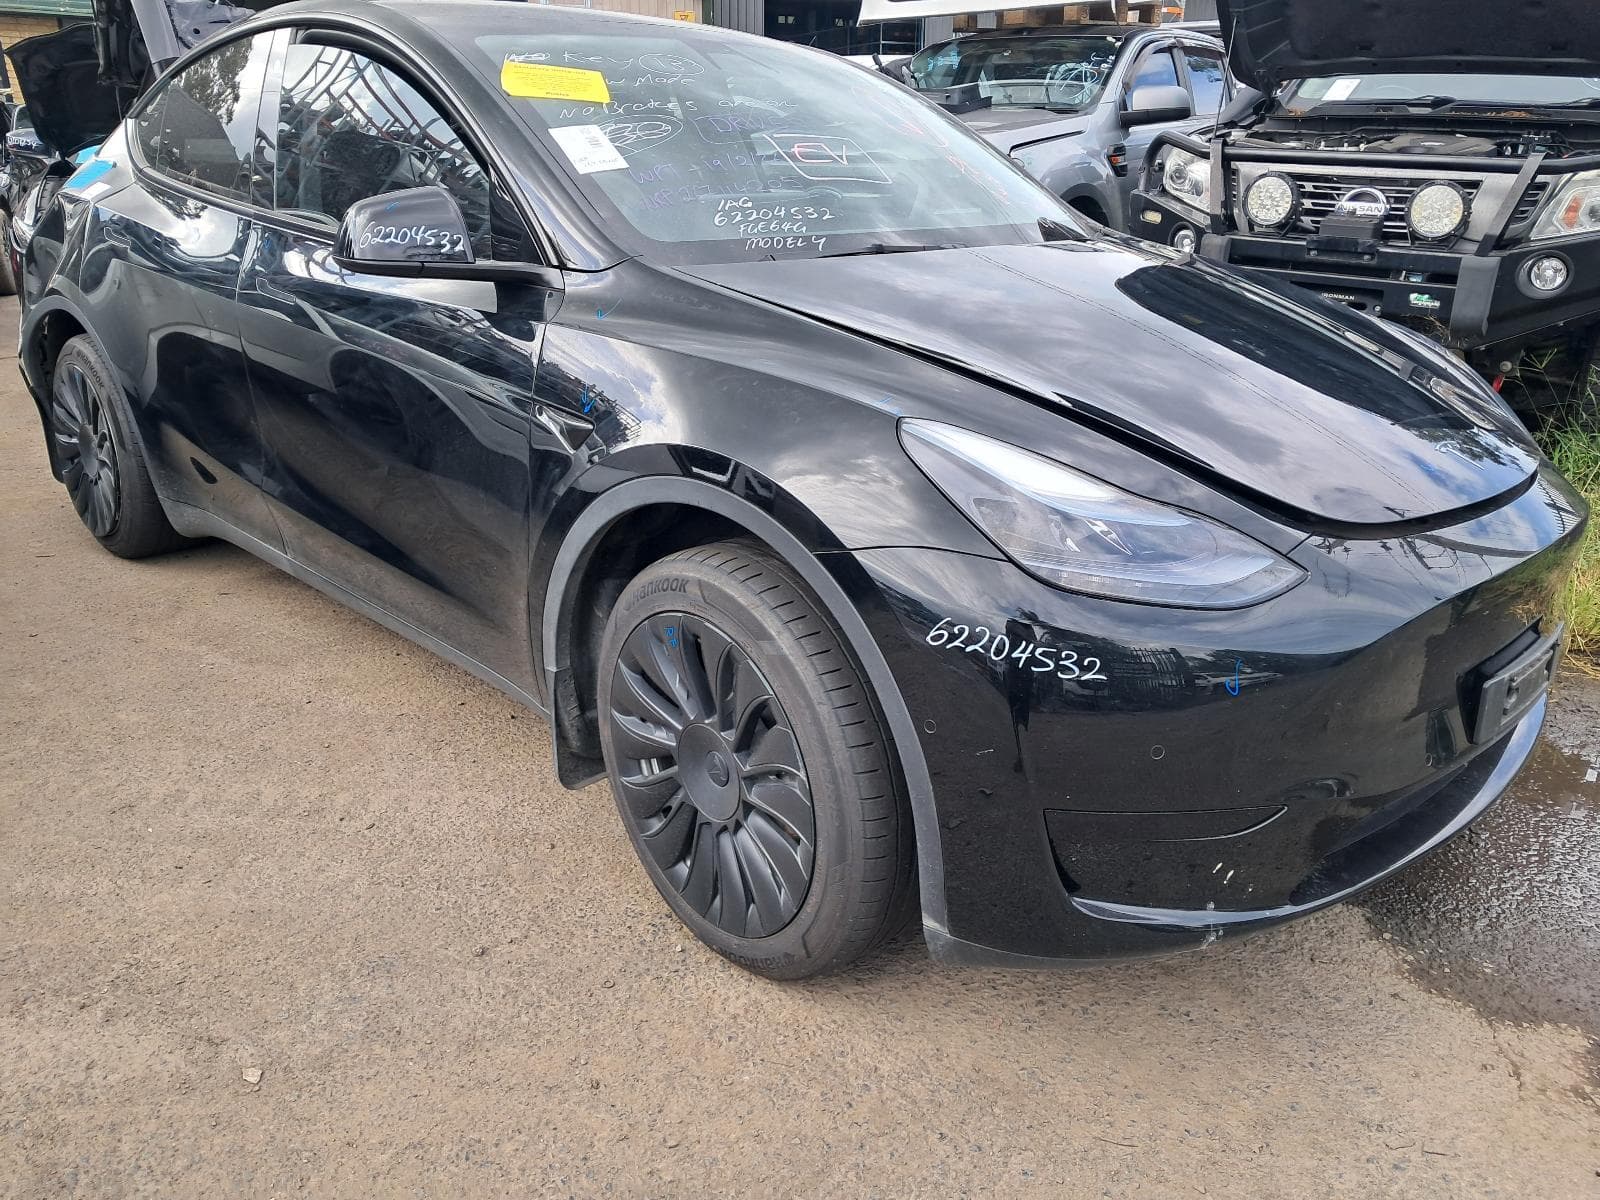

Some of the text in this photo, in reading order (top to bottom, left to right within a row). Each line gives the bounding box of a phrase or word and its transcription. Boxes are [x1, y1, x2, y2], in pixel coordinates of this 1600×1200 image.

[791, 142, 849, 167] EV
[713, 206, 836, 226] 62204532
[1338, 204, 1383, 214] NISSAN
[359, 221, 465, 252] 62204532
[745, 237, 808, 251] MODEL
[925, 616, 1109, 681] 62204532
